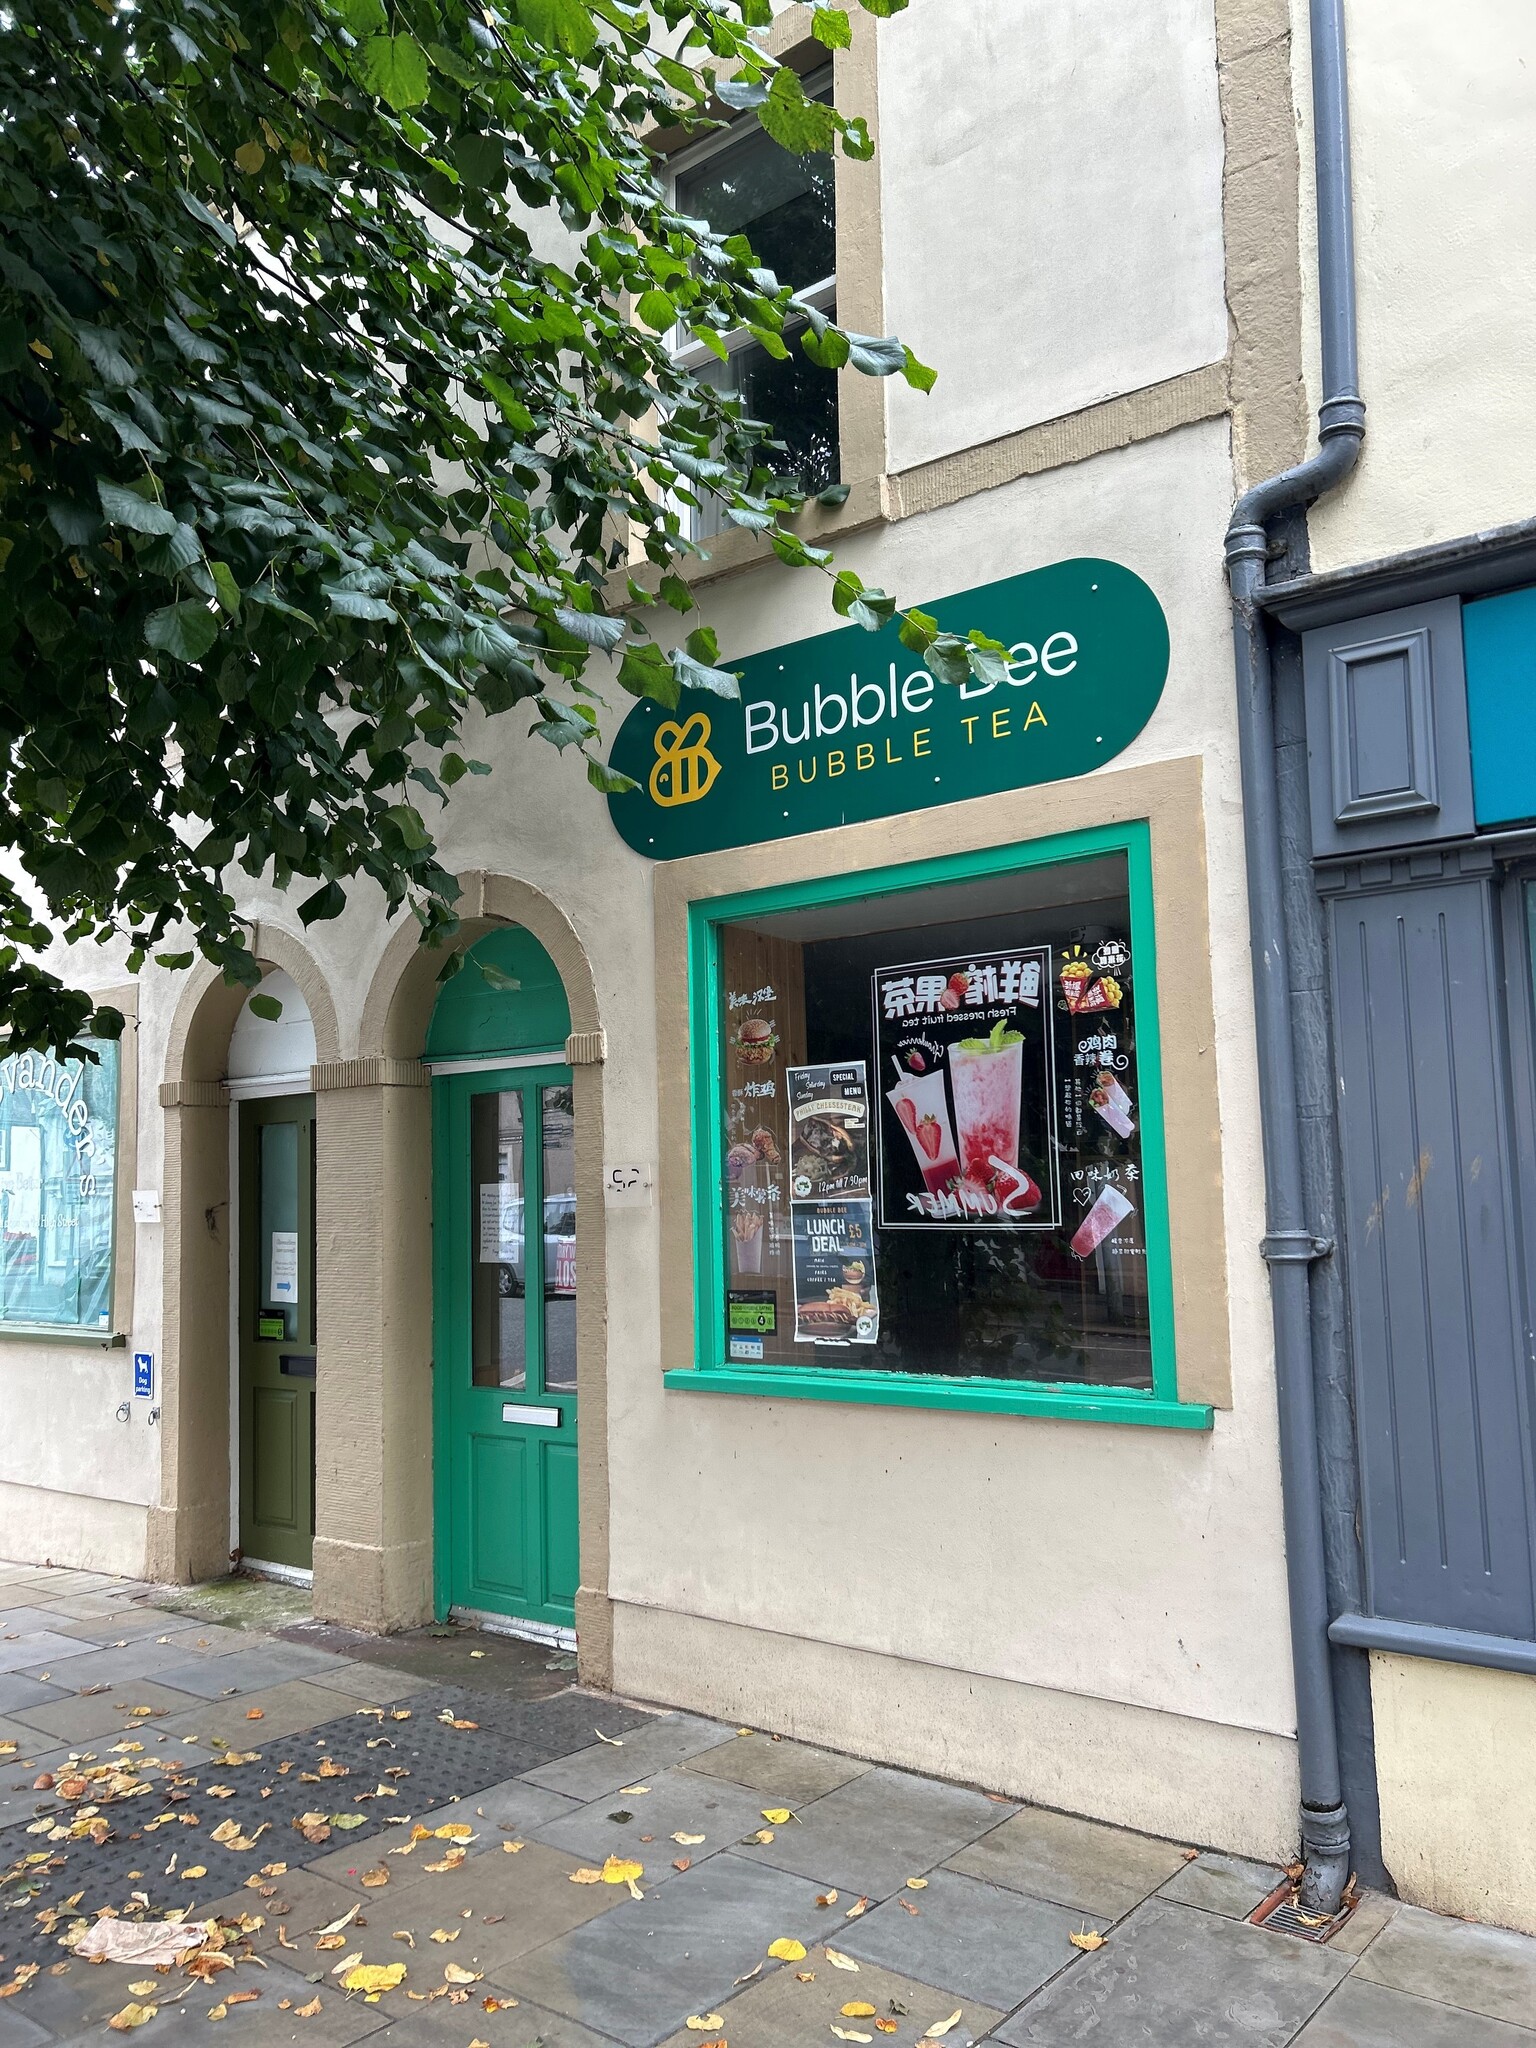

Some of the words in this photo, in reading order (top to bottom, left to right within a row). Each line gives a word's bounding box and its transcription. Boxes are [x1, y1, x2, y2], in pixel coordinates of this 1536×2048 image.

[745, 662, 934, 755] Bubble
[958, 629, 1079, 701] ee
[772, 727, 933, 791] BUBBLE
[960, 700, 1049, 745] TEA
[1086, 1034, 1118, 1050] 鸡肉
[794, 1071, 811, 1082] Friday
[832, 1072, 855, 1082] SPECIAL
[805, 1080, 826, 1090] Saturday
[844, 1086, 862, 1096] MENU
[796, 1091, 814, 1101] Sunday
[816, 1101, 862, 1114] CHEESESTEAK
[818, 1181, 835, 1194] 12pm
[806, 1218, 846, 1235] LUNCH
[848, 1223, 862, 1239] £5
[812, 1236, 845, 1252] DEAL
[138, 1376, 148, 1386] Dog
[135, 1386, 151, 1394] parking
